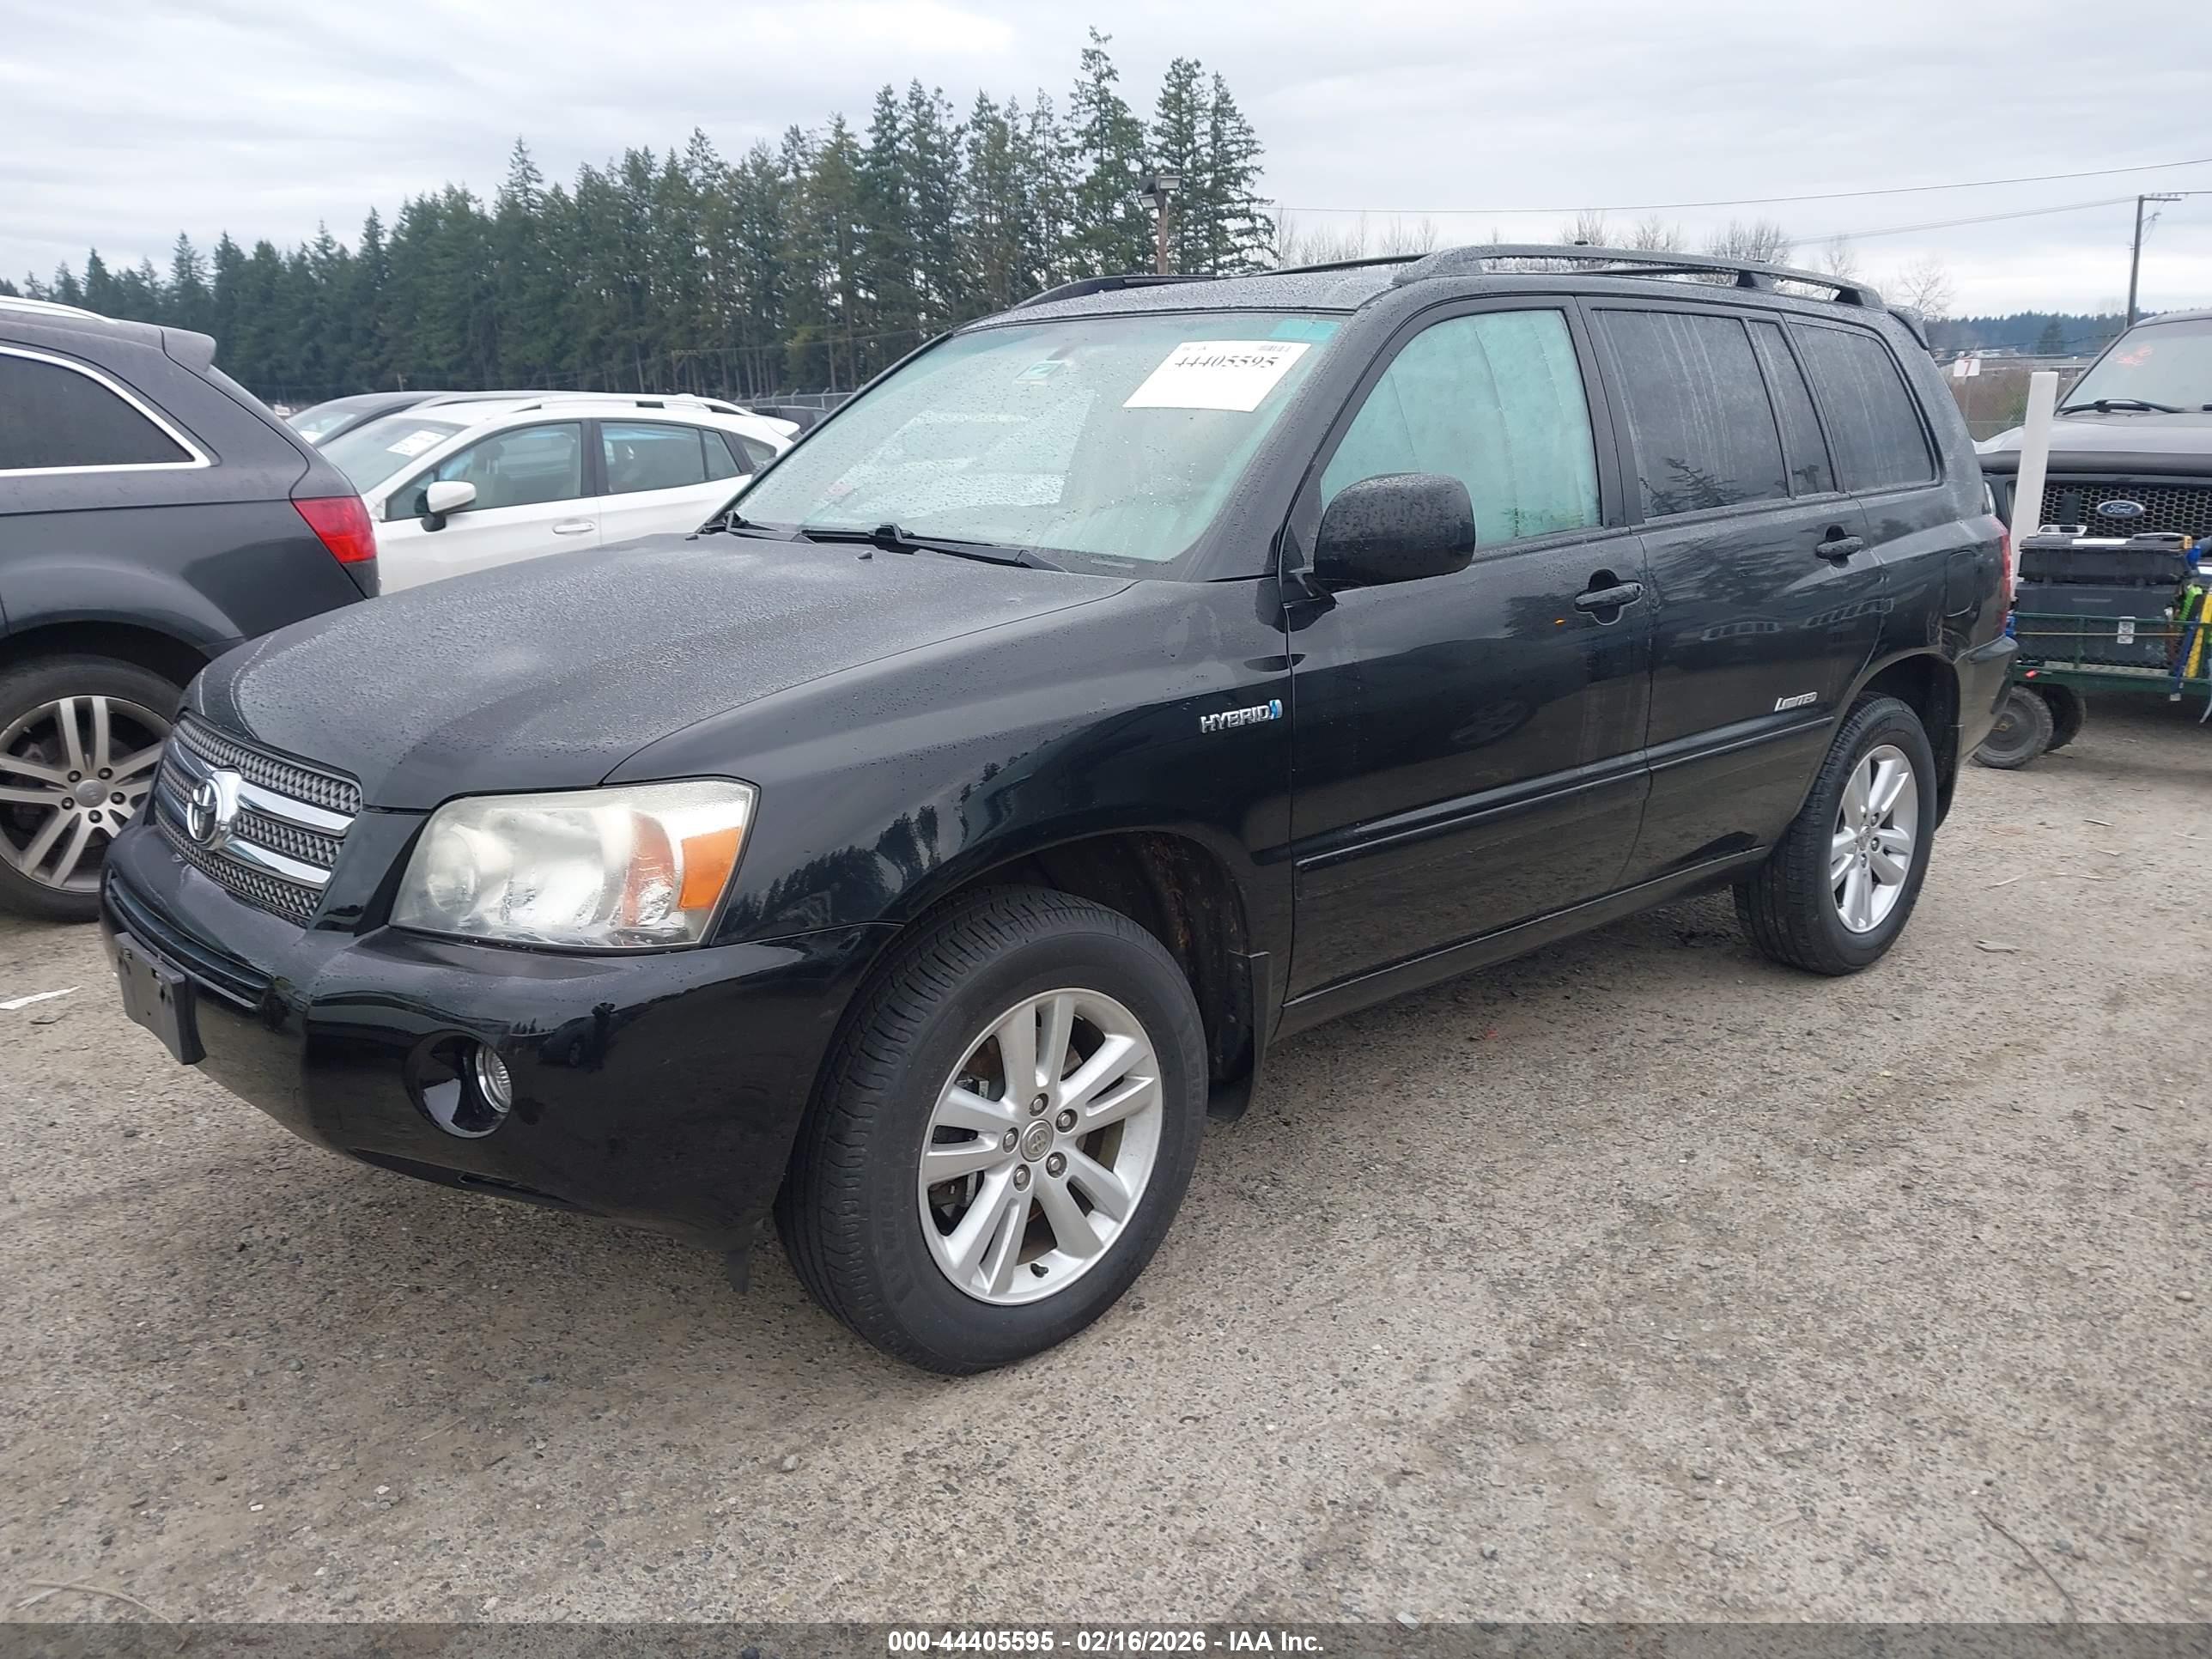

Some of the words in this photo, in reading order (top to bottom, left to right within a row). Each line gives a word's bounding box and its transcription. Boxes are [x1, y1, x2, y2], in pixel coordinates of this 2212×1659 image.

[1174, 355, 1279, 369] 44405595
[1963, 359, 1973, 376] 7
[2106, 503, 2135, 514] Ford
[1200, 704, 1271, 734] HYBRID
